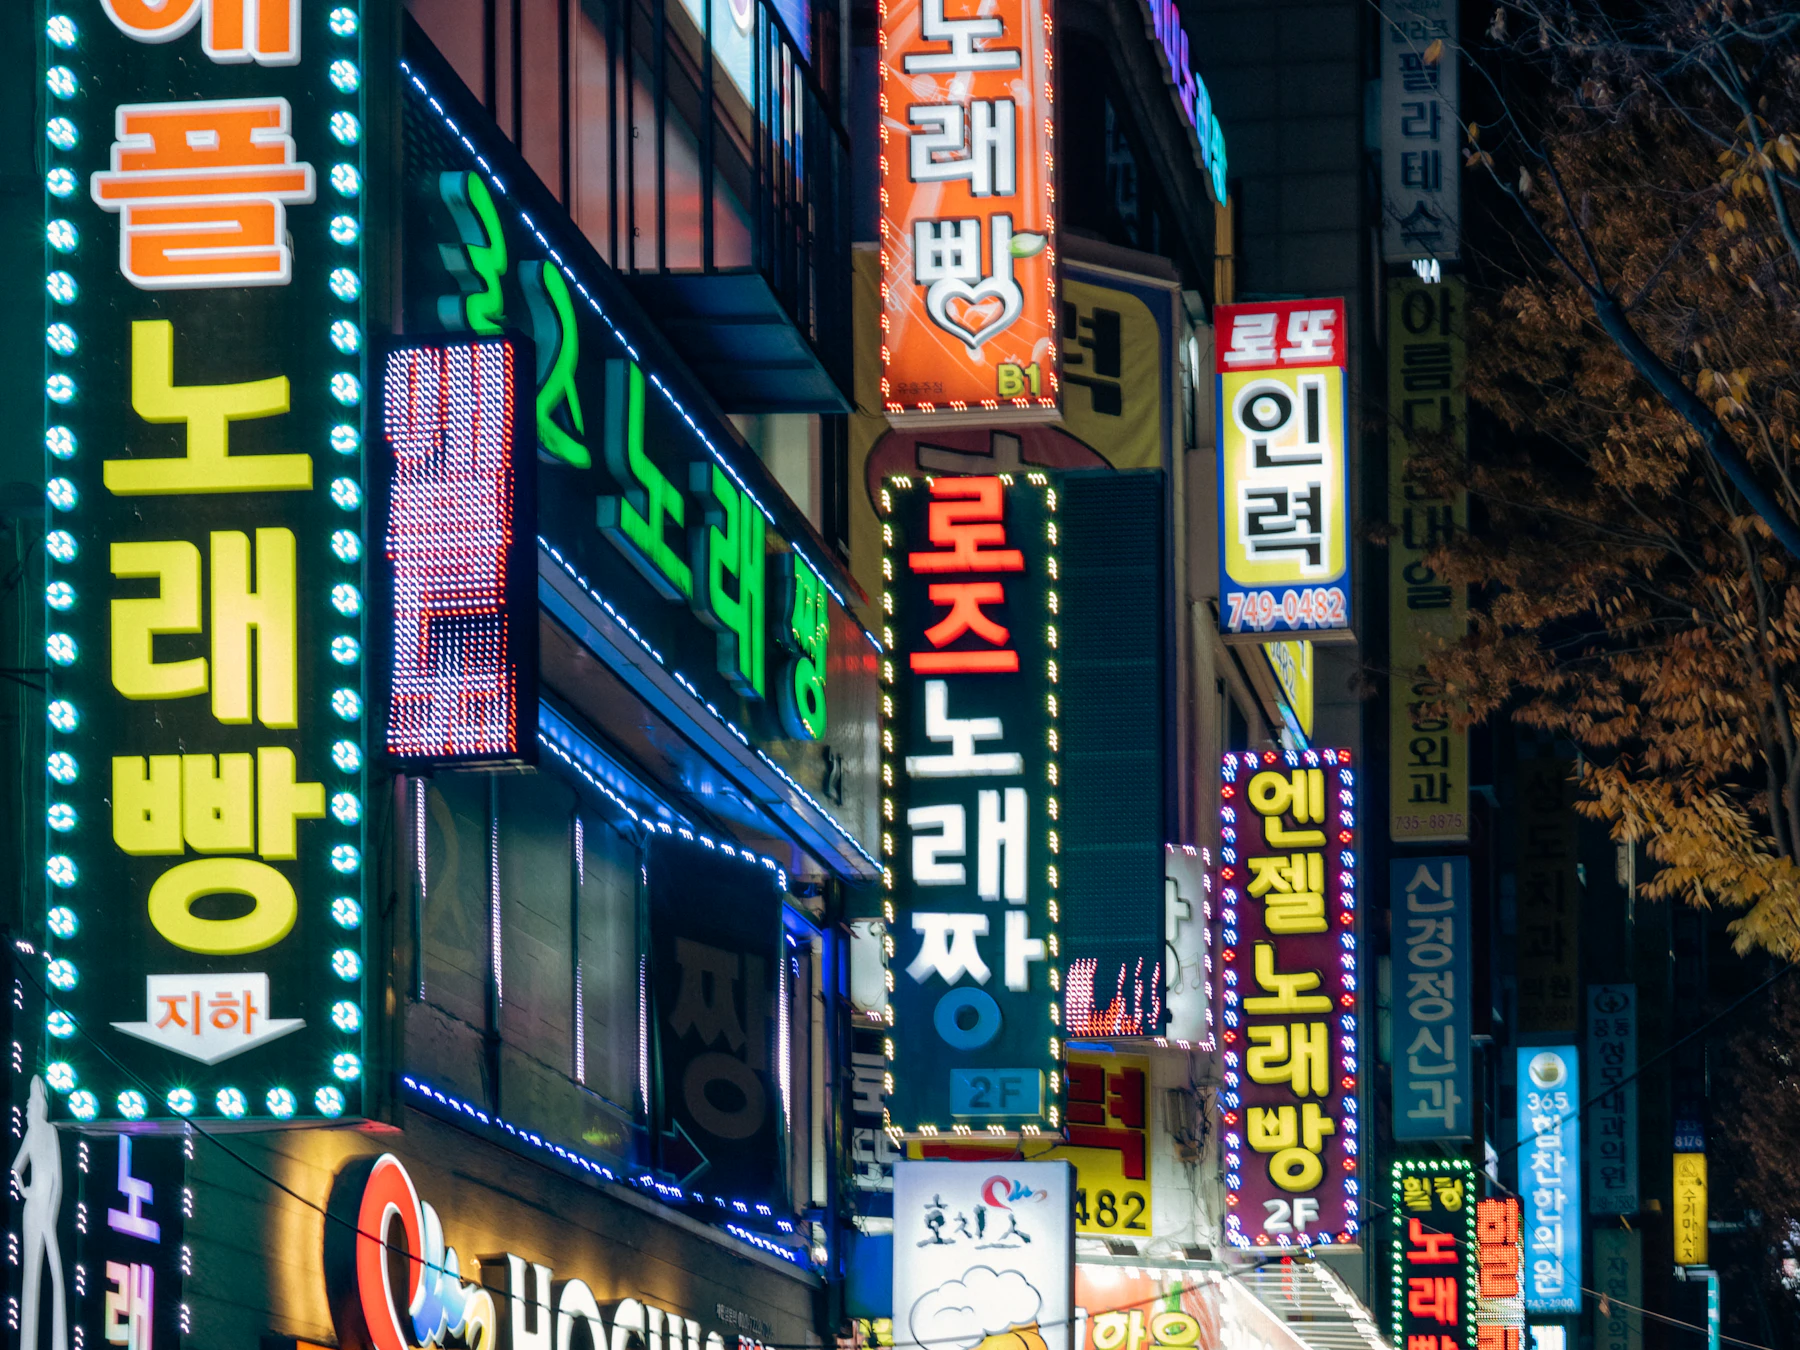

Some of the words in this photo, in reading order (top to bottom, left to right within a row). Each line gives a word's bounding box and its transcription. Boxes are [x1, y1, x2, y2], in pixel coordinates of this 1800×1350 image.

[1397, 52, 1442, 243] 필라테스
[1223, 310, 1336, 364] 로또
[997, 363, 1042, 397] B1
[1231, 374, 1330, 574] 인력
[1226, 587, 1347, 631] 749-0482
[103, 320, 326, 956] 노래빵
[1243, 768, 1335, 1191] 엔젤노래방
[1405, 862, 1462, 1130] 신경정신과
[154, 989, 259, 1036] 지하
[968, 1075, 1023, 1109] 2F
[1527, 1091, 1569, 1111] 365
[916, 1193, 1032, 1249] 호치스
[1262, 1198, 1319, 1234] 2F
[1681, 1188, 1699, 1259] 수기마사지
